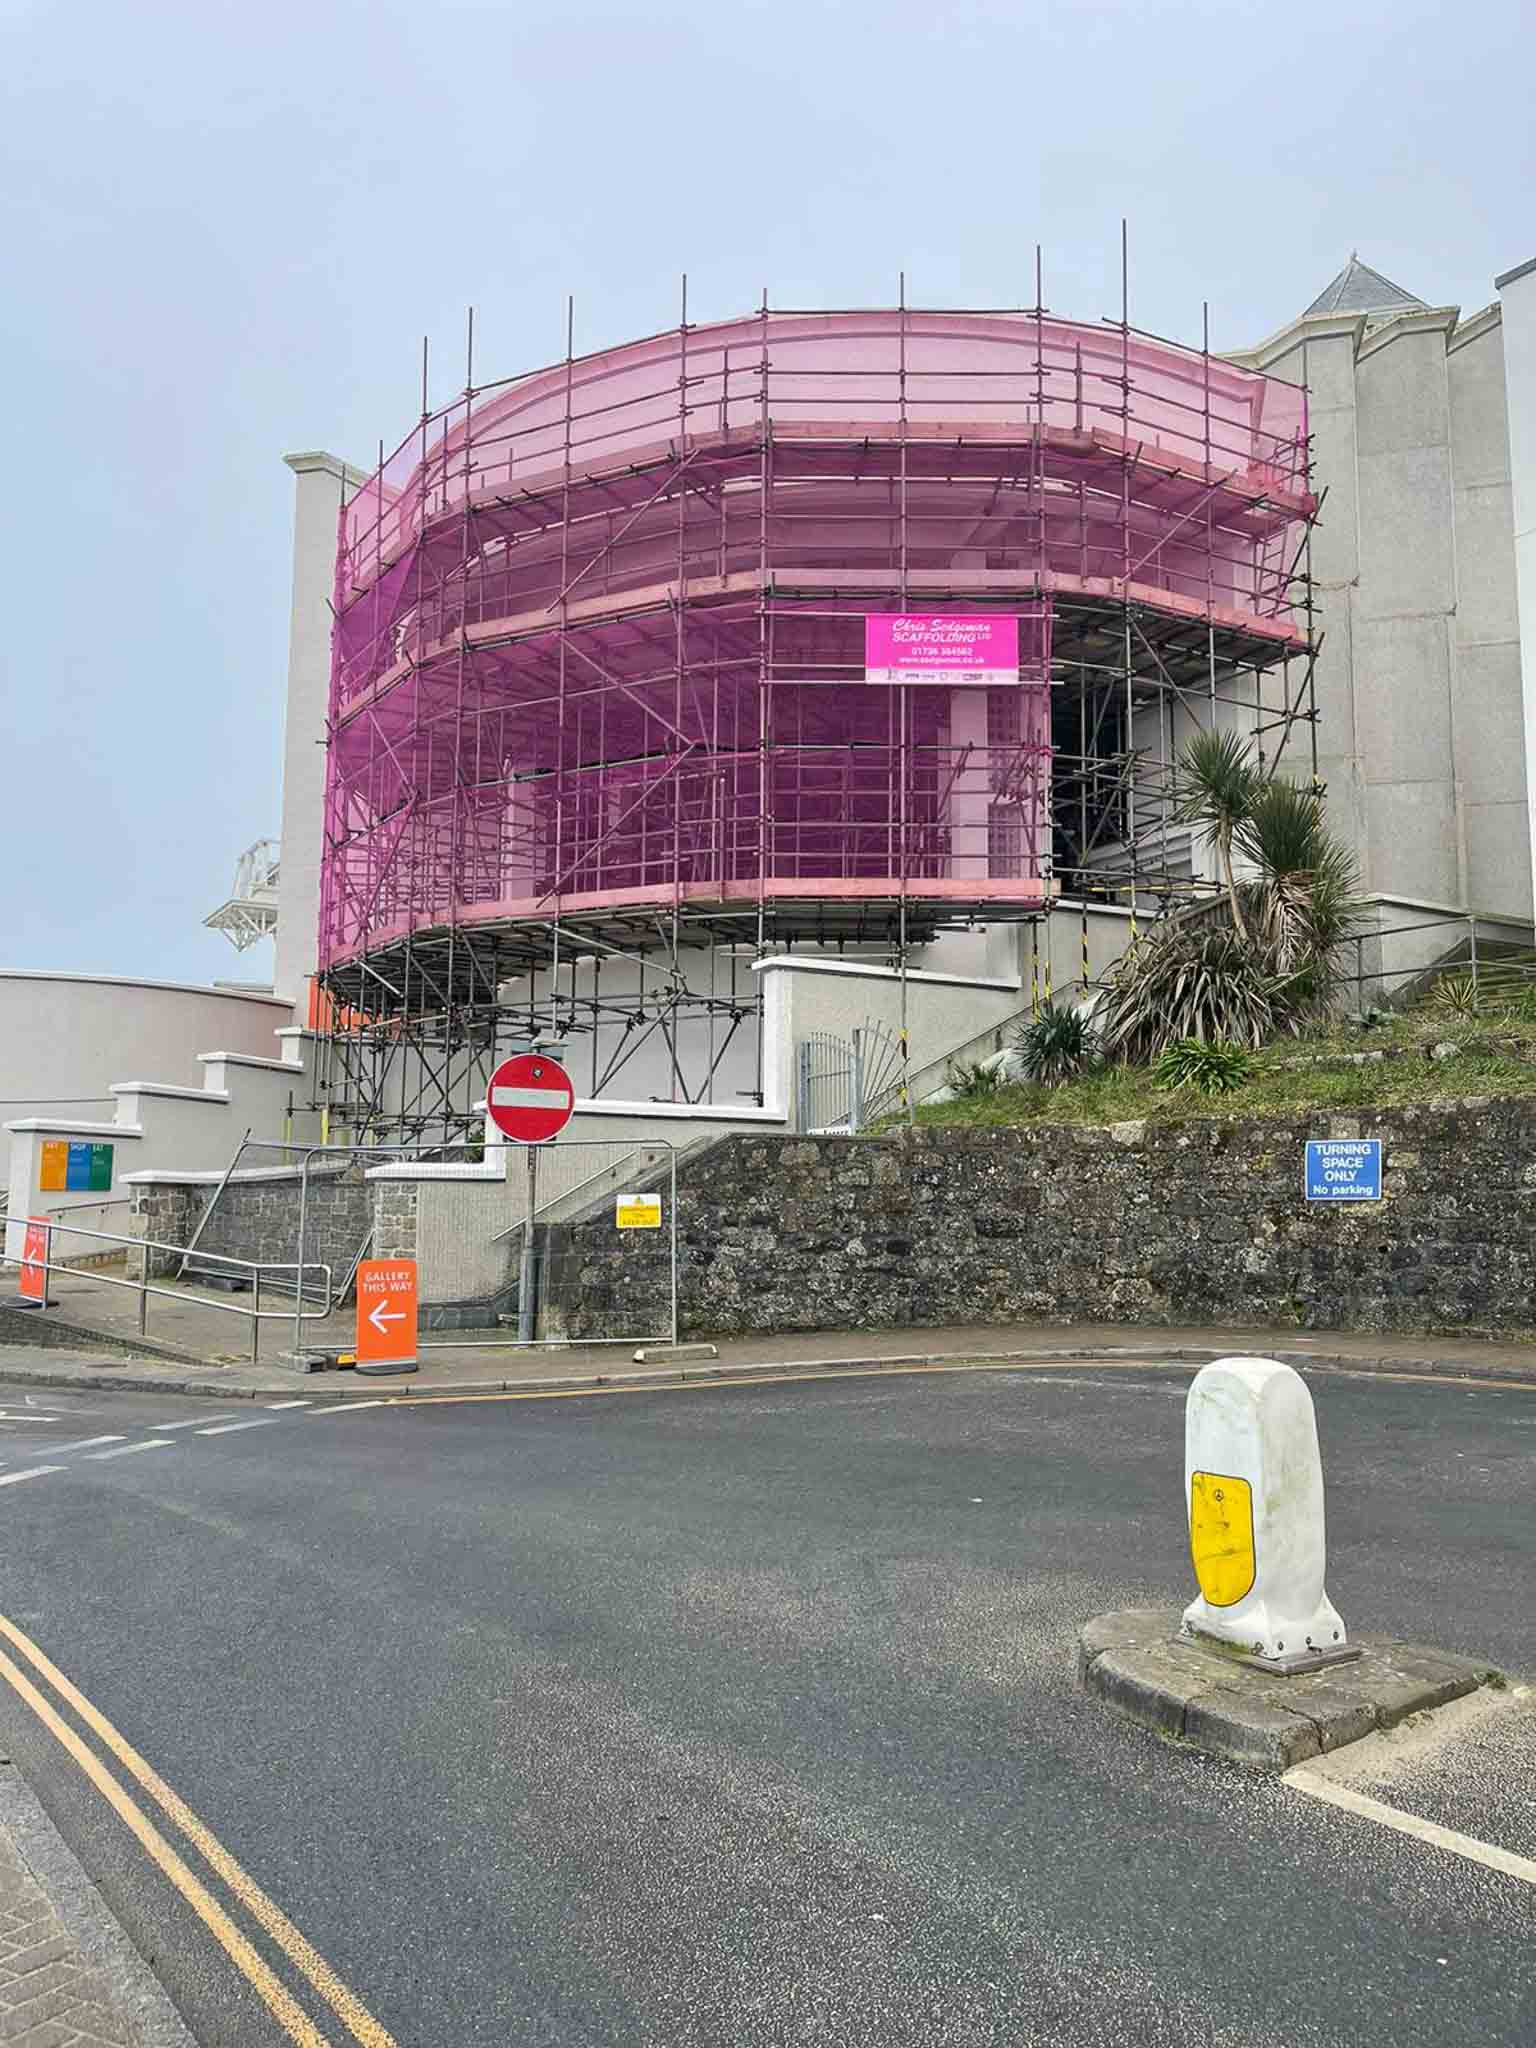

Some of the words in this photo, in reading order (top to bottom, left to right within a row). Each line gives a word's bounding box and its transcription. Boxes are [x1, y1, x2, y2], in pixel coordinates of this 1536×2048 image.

[892, 618, 926, 632] Chris
[892, 631, 977, 643] SCAFFOLDING
[1315, 1144, 1372, 1155] TURNING
[1322, 1157, 1365, 1168] SPACE
[1324, 1170, 1357, 1182] ONLY
[1313, 1185, 1328, 1194] No
[1332, 1185, 1374, 1196] parking
[365, 1271, 411, 1281] GALLERY
[363, 1282, 385, 1293] THIS
[390, 1281, 413, 1291] WAY
